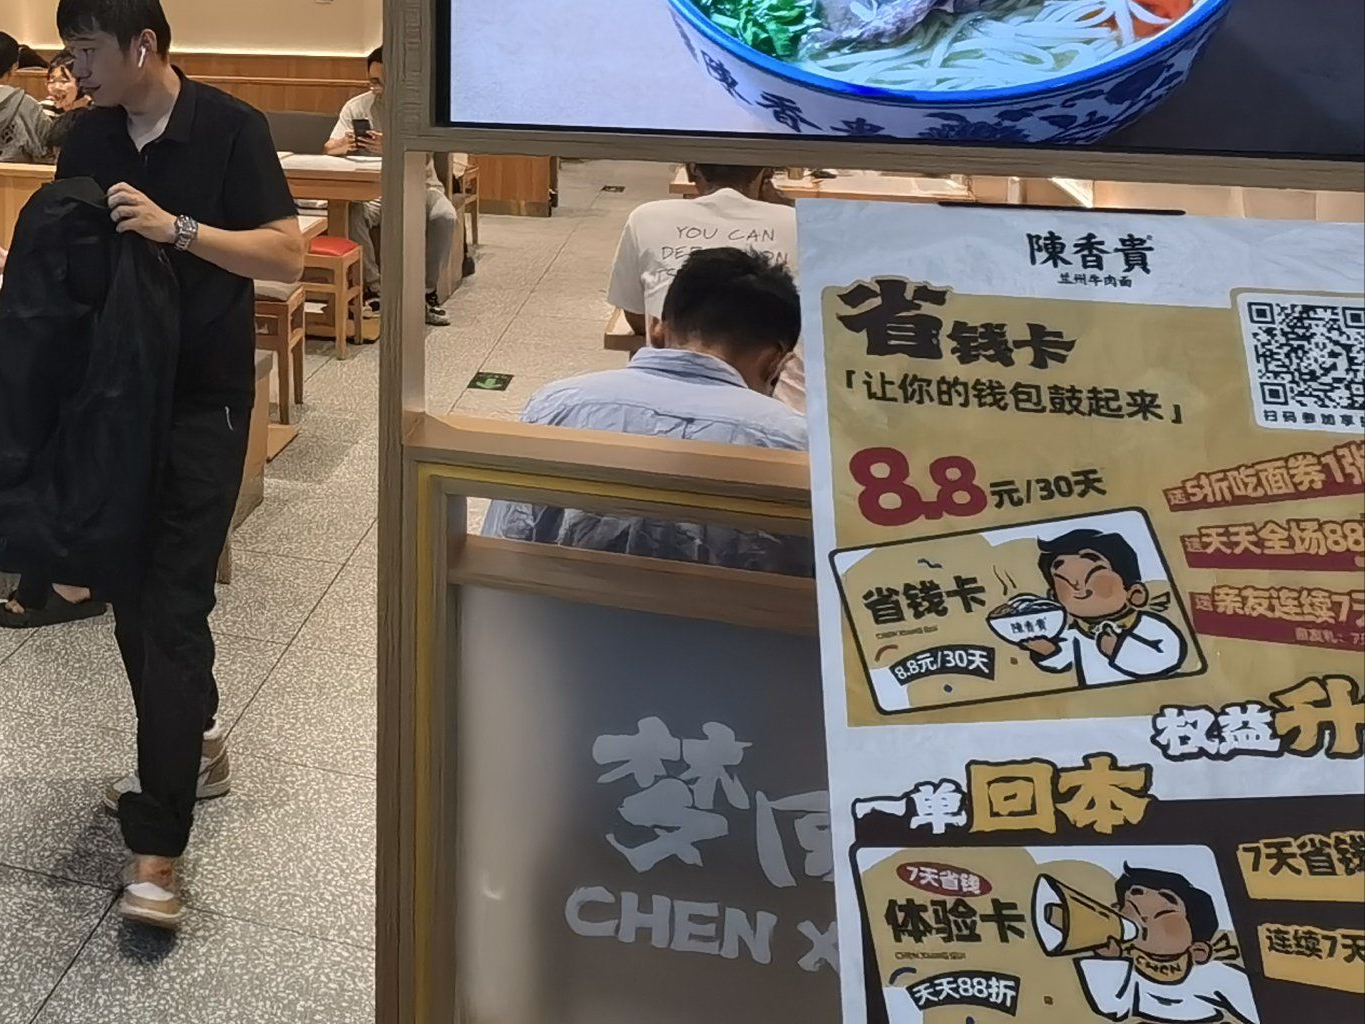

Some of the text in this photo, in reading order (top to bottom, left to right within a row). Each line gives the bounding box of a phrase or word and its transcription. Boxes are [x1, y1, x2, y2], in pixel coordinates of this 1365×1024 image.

[676, 226, 775, 242] YOU CAN
[1025, 230, 1154, 275] 陳香貴
[1057, 272, 1132, 288] 兰州牛肉面
[835, 279, 1077, 370] 省钱卡
[862, 576, 986, 625] 省钱卡
[893, 648, 990, 680] 8.8元/30天
[855, 756, 1149, 835] 一单回本
[906, 866, 982, 894] 7天省钱
[565, 886, 777, 964] CHEN
[884, 898, 1027, 943] 体验卡
[913, 976, 1016, 1007] 天天88折
